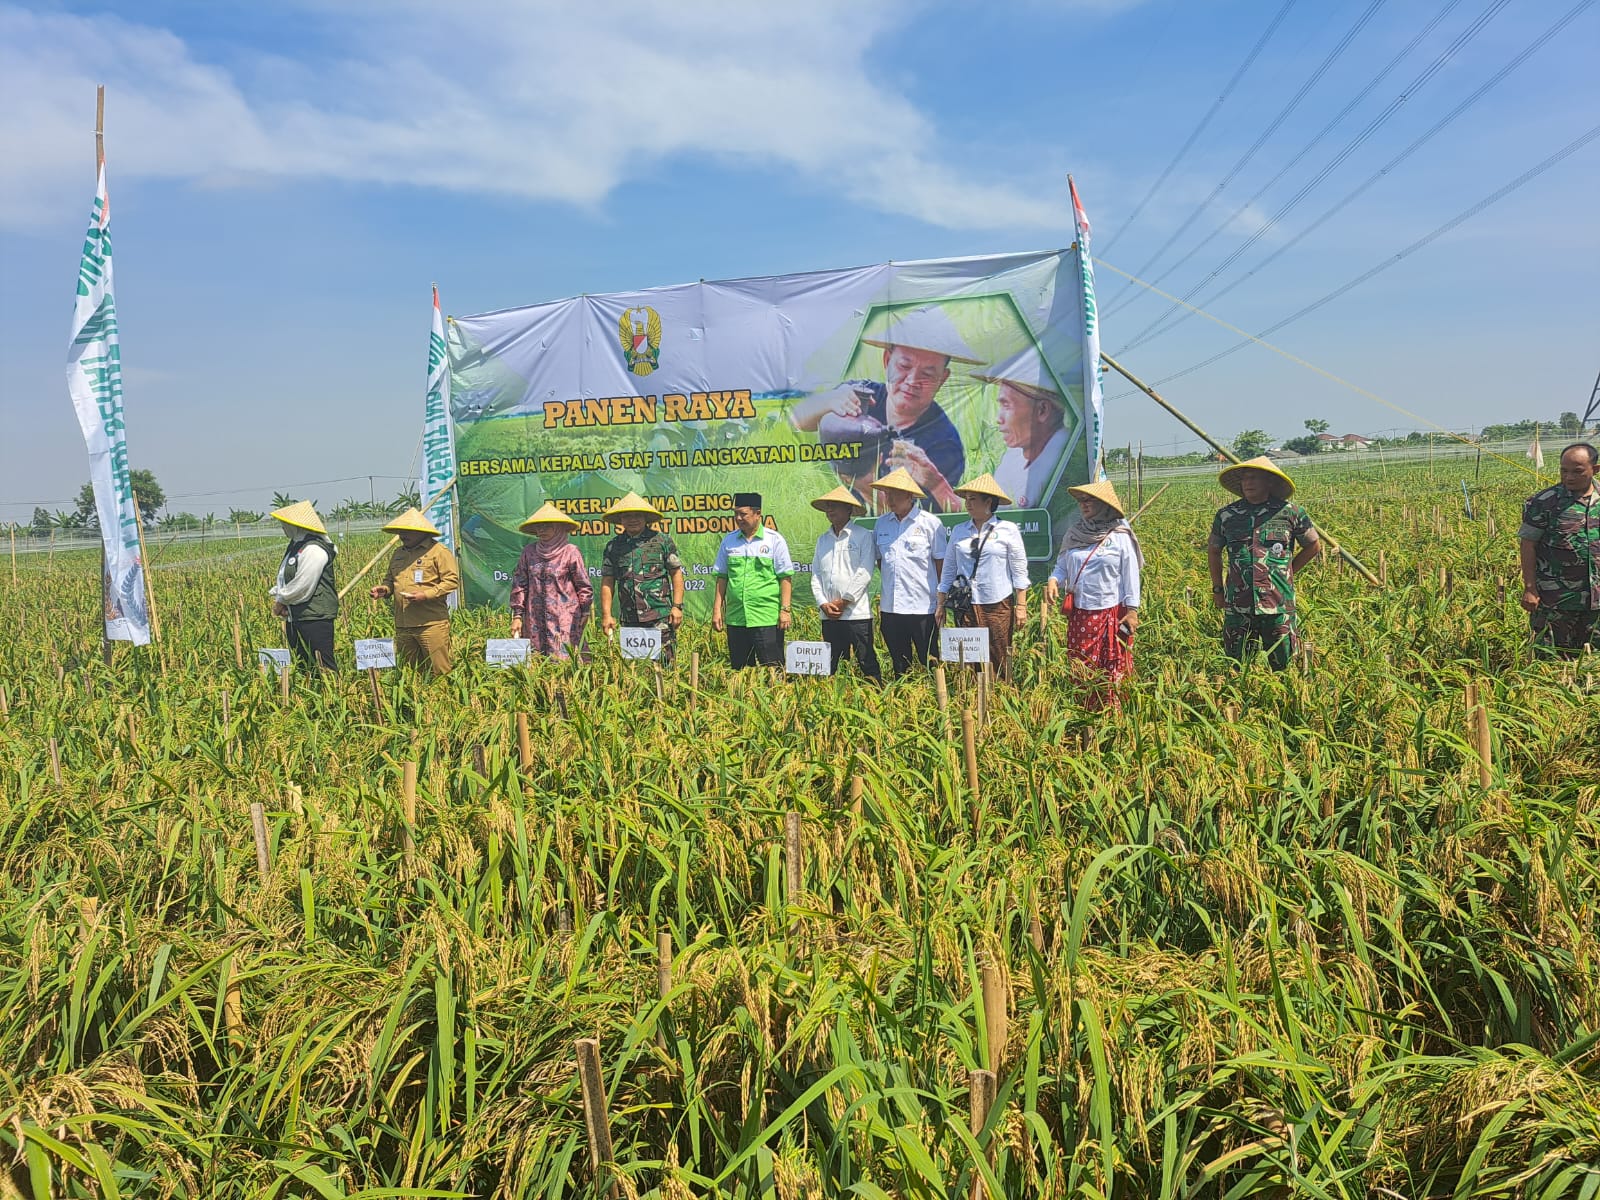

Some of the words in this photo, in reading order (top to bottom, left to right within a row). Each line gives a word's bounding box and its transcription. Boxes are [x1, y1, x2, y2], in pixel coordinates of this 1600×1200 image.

[543, 394, 657, 429] PANEN
[663, 389, 755, 423] RAYA
[459, 456, 536, 476] BERSAMA
[539, 453, 605, 473] KEPALA
[609, 450, 654, 469] STAF
[657, 449, 688, 467] TNI
[693, 444, 797, 466] ANGKATAN
[800, 441, 862, 461] DARAT
[682, 494, 735, 512] DENG
[676, 515, 778, 533] INDONA
[494, 570, 513, 581] Ds.
[684, 578, 706, 591] 022
[625, 637, 656, 648] KSAD
[796, 646, 823, 656] DIRUT
[795, 661, 808, 669] PT.
